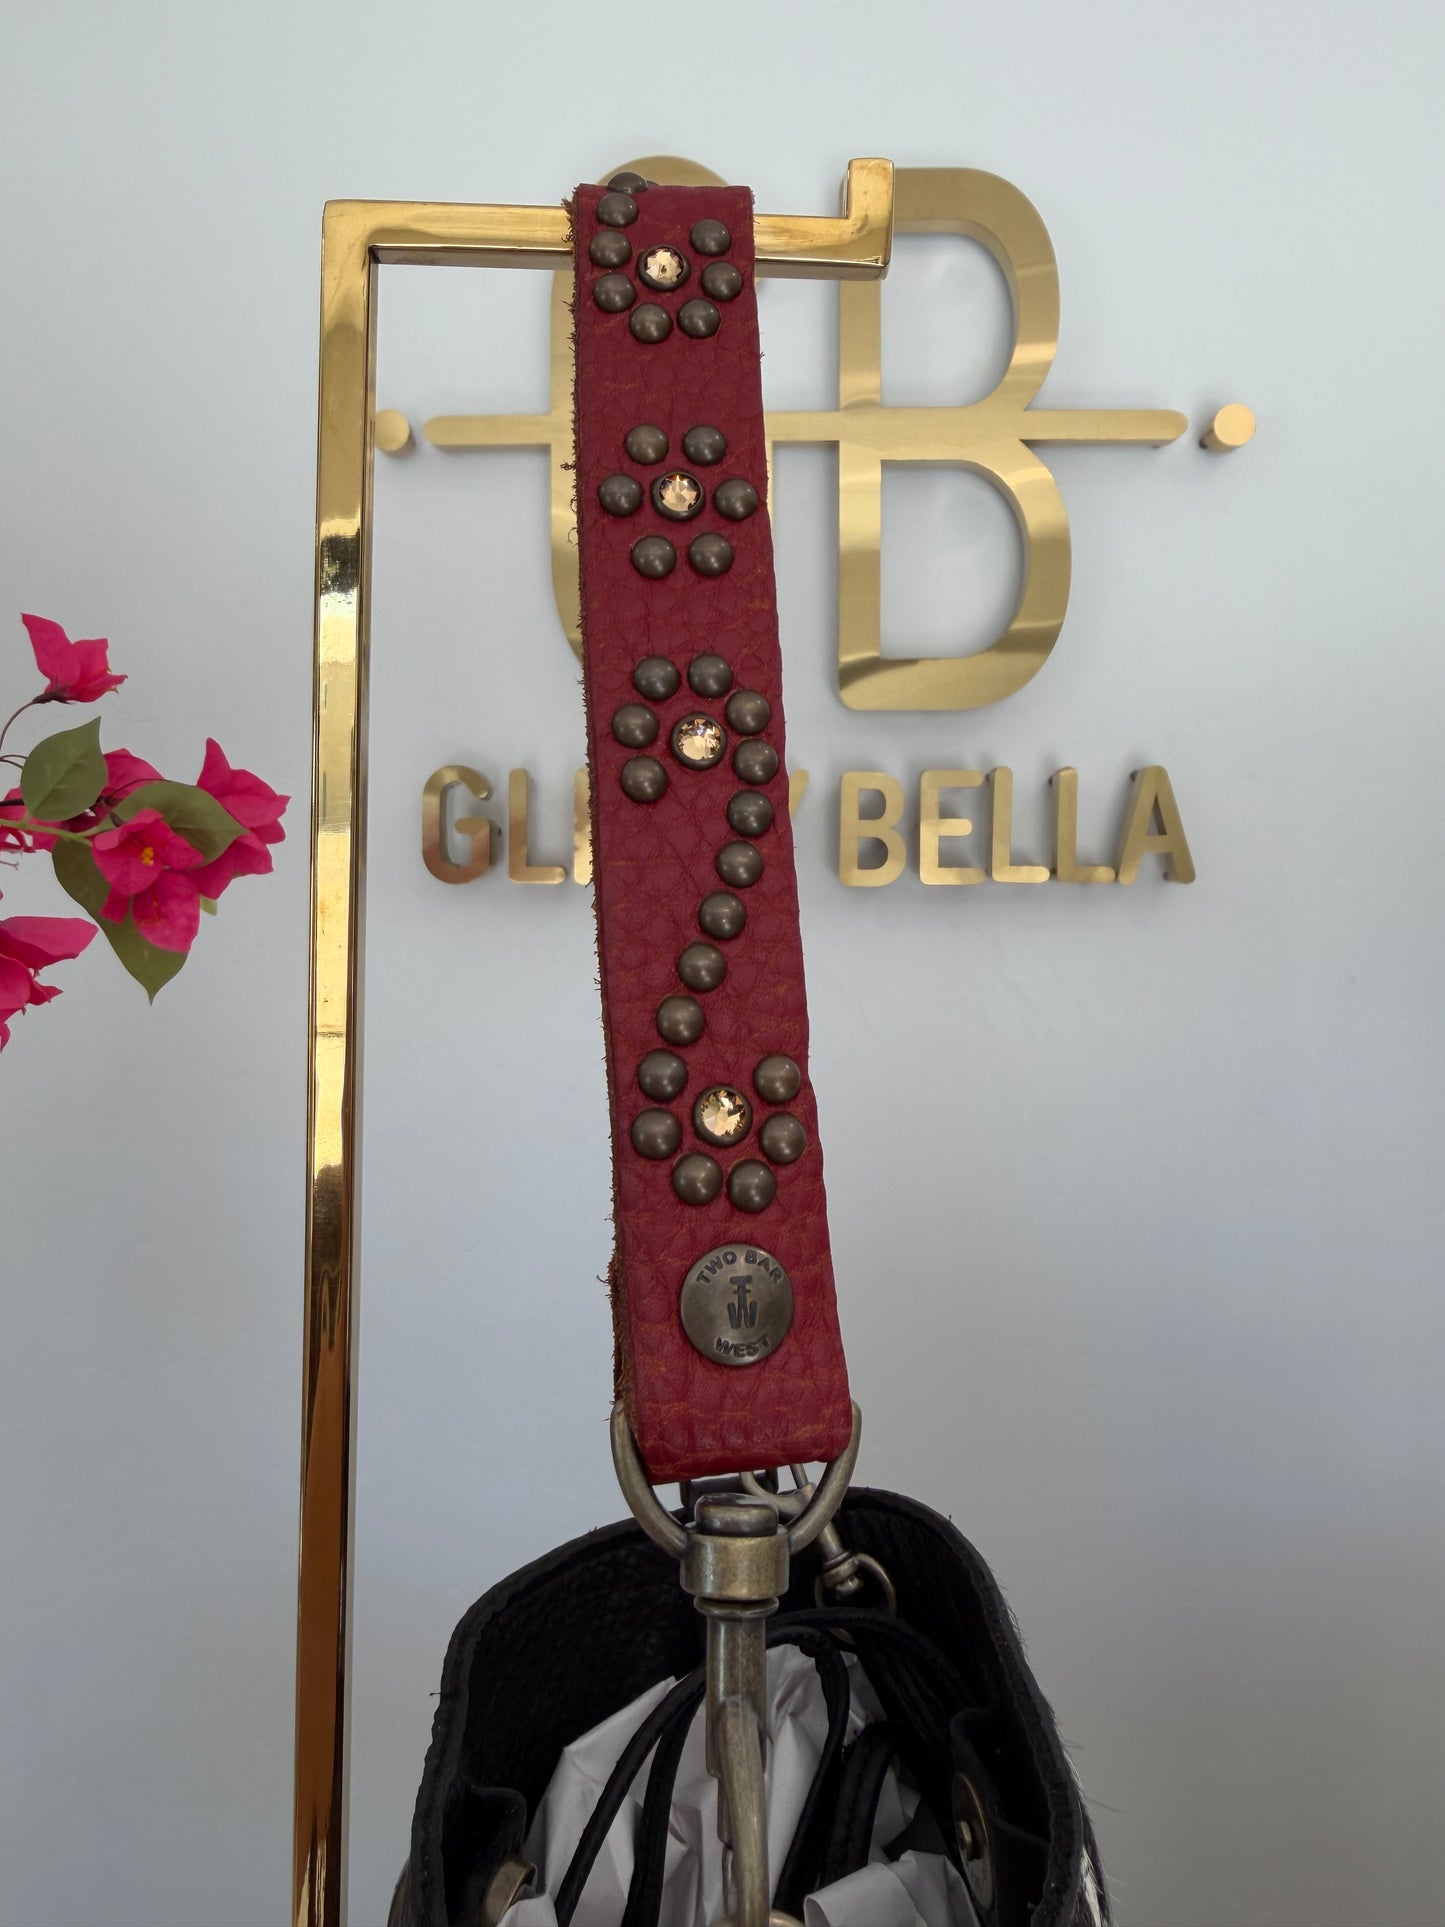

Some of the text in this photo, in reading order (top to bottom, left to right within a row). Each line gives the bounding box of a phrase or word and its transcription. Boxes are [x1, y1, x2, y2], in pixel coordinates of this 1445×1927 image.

[696, 1249, 784, 1284] TWO BAR
[715, 1333, 771, 1358] WEST
